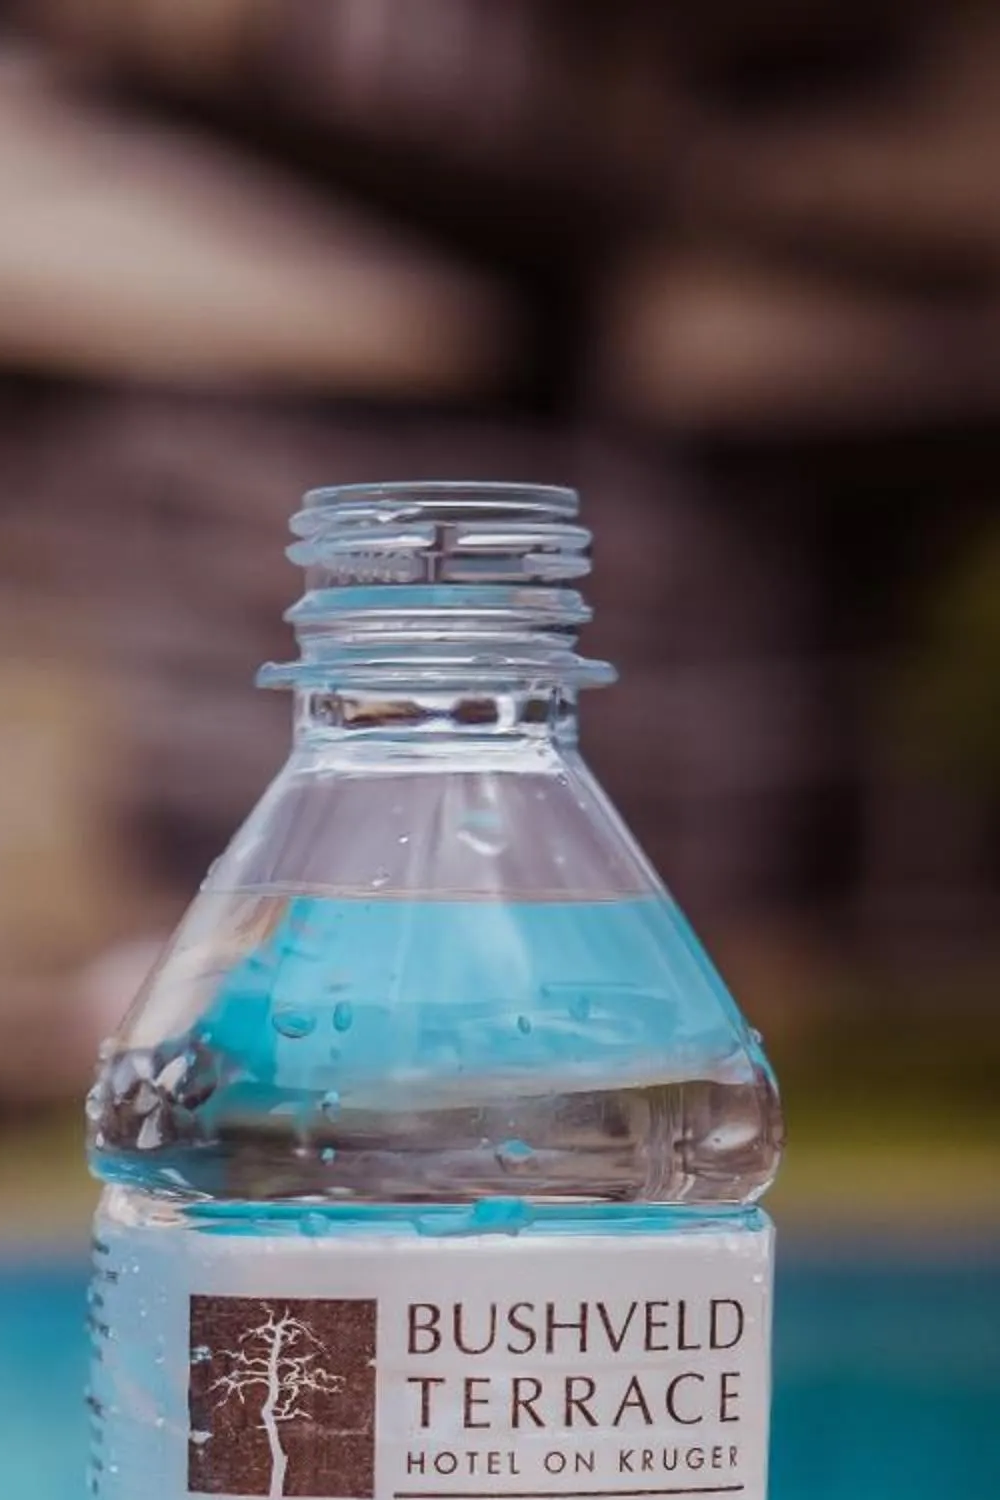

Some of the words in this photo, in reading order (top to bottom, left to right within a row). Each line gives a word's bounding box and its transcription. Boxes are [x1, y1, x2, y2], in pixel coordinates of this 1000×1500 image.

[408, 1299, 744, 1354] BUSHVELD
[407, 1372, 740, 1428] TERRACE
[407, 1451, 520, 1475] HOTEL
[543, 1451, 594, 1474] ON
[619, 1445, 737, 1473] KRUGER
